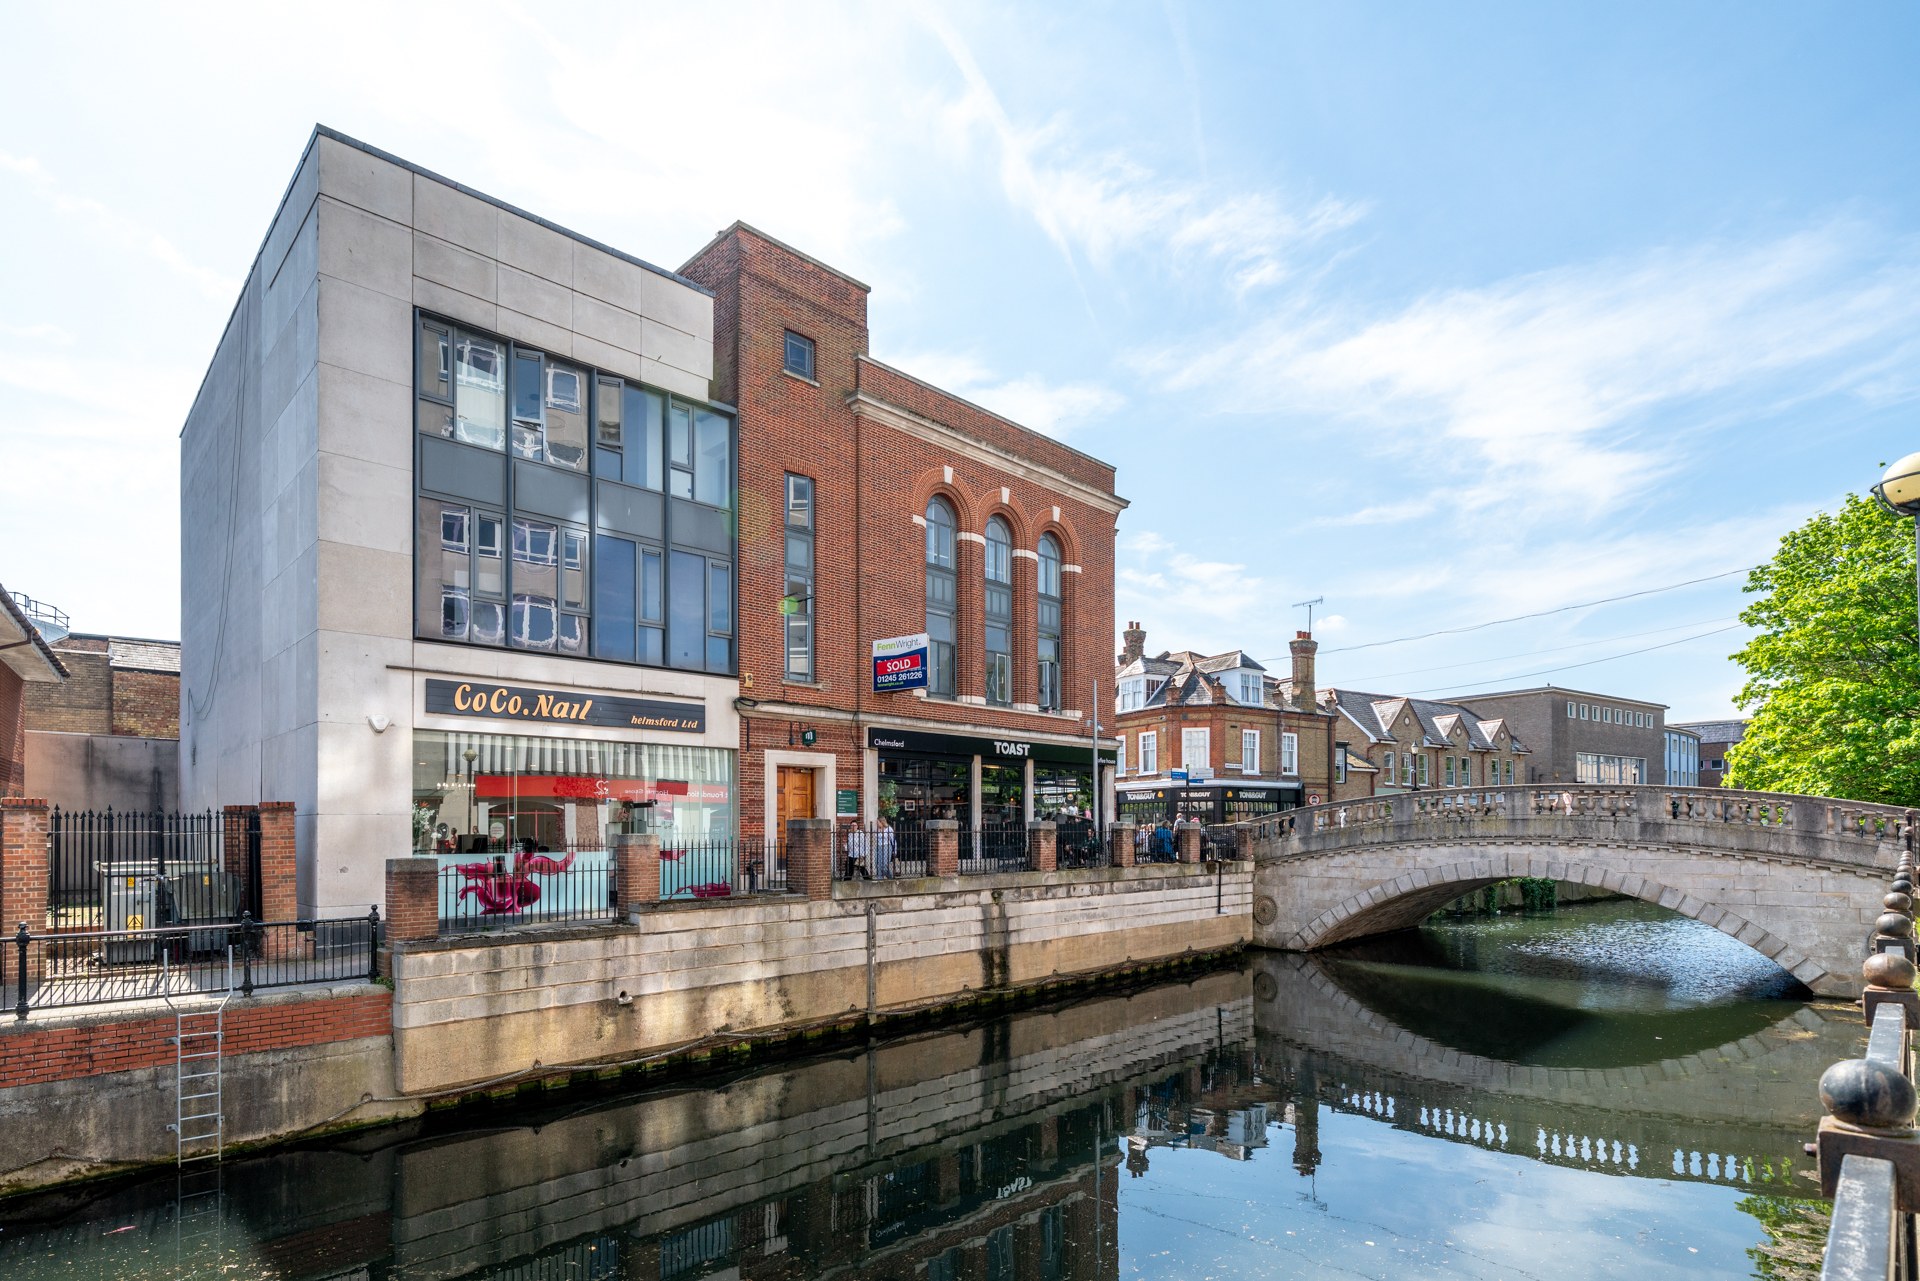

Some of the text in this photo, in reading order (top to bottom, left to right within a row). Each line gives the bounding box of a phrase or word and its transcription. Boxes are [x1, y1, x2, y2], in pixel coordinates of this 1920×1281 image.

[886, 659, 911, 672] SOLD
[877, 671, 923, 683] 01245 261226
[631, 715, 698, 729] helmsford Ltd
[873, 738, 905, 748] Chelmsford
[994, 741, 1031, 756] TOAST
[1127, 793, 1156, 801] TONI&GUY
